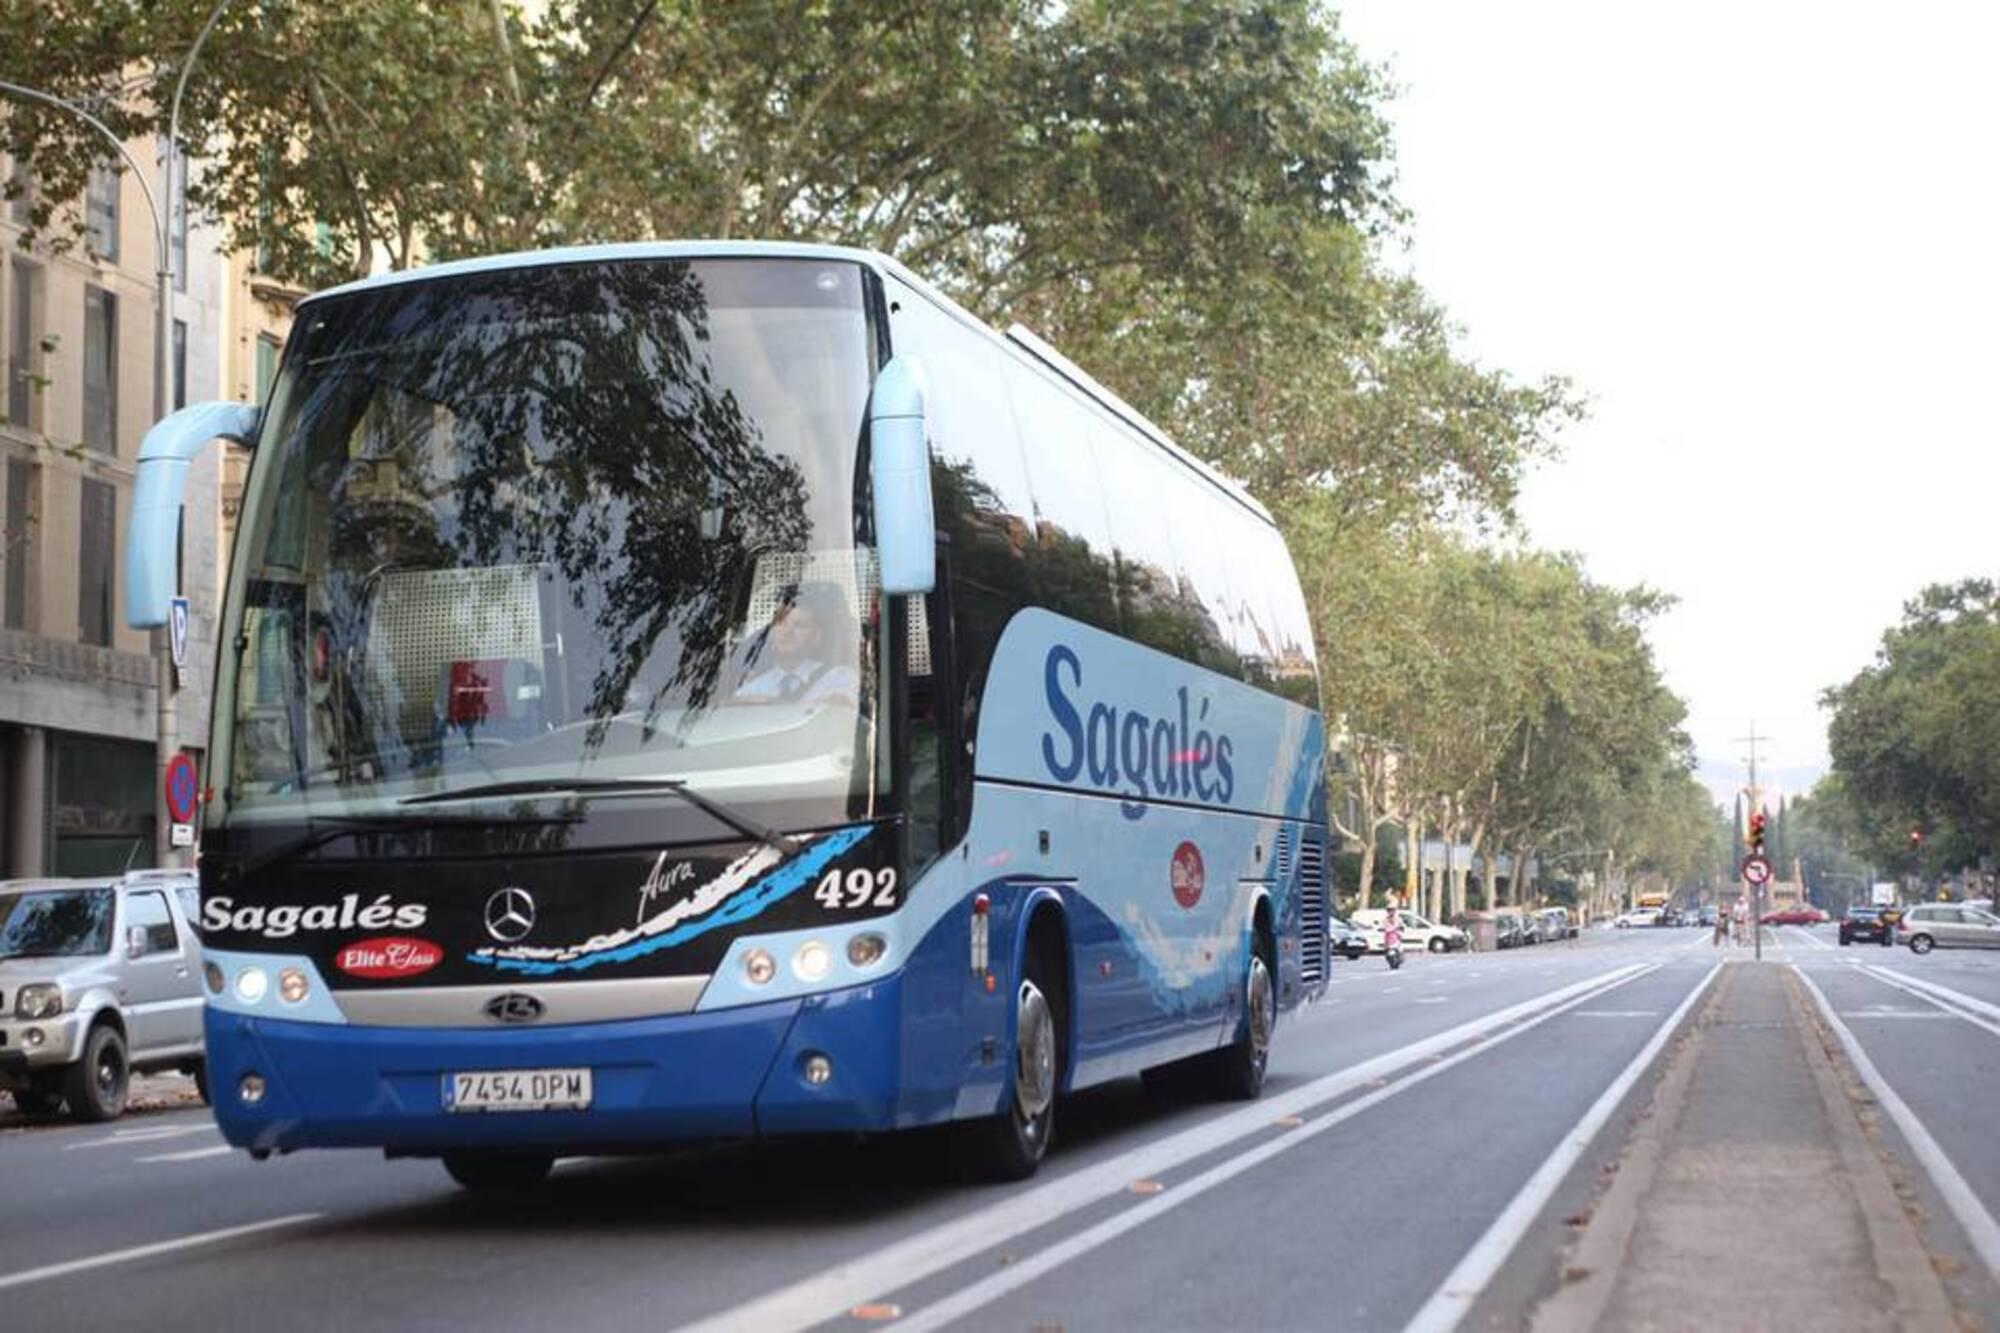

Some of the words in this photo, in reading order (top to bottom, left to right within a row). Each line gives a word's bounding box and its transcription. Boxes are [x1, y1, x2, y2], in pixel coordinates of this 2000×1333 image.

[1041, 643, 1234, 821] Sagalés
[637, 849, 696, 924] Aura
[814, 866, 897, 909] 492
[202, 893, 428, 938] Sagalés
[344, 949, 386, 968] Elite
[457, 1074, 524, 1102] 7454
